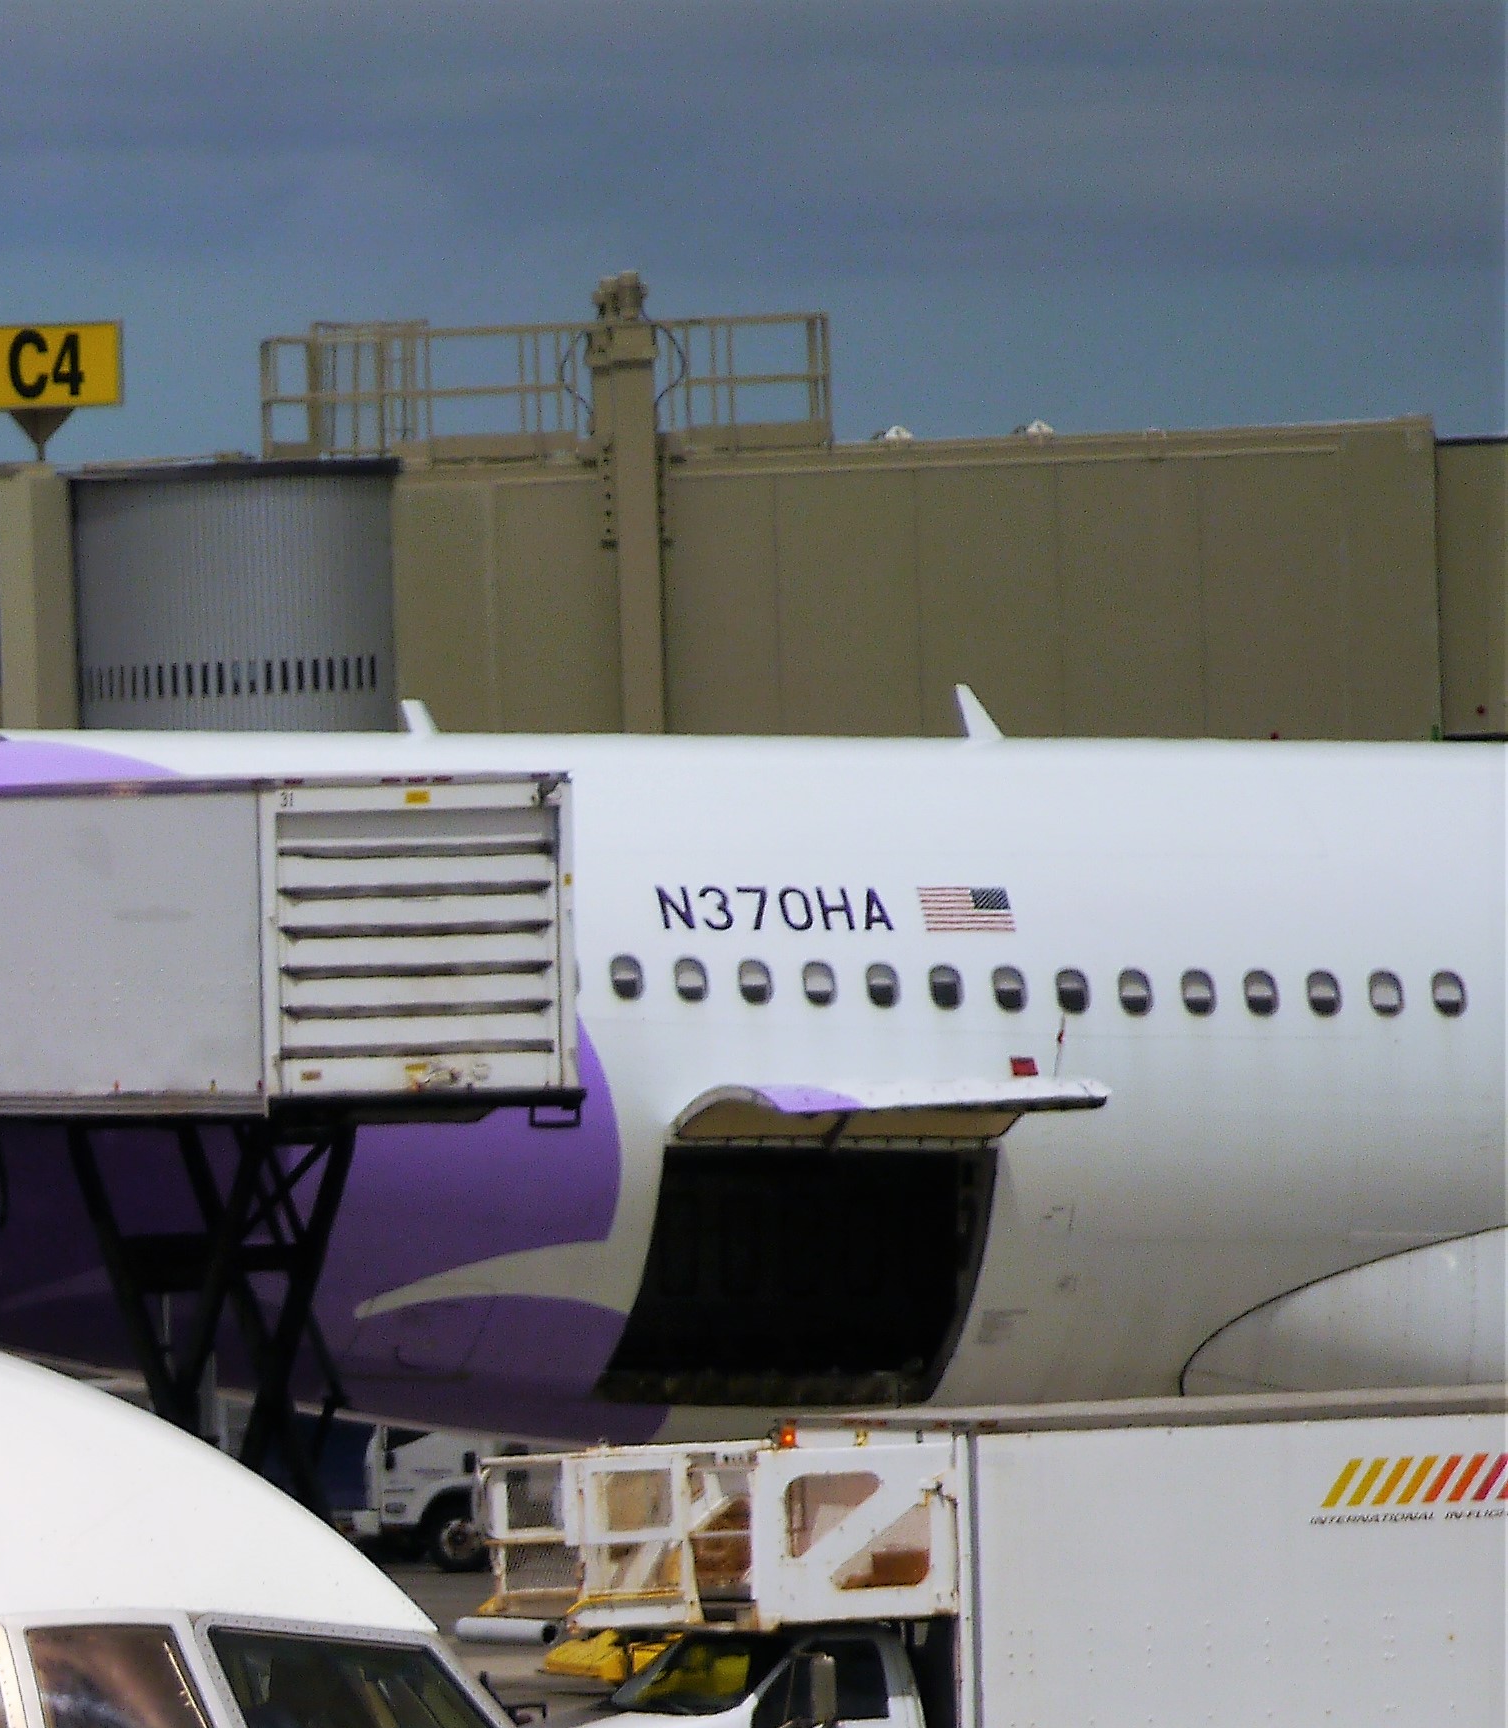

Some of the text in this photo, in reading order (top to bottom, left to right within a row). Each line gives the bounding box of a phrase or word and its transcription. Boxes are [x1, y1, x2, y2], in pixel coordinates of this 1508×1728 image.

[9, 329, 84, 398] C4
[655, 886, 895, 931] N370HA
[1309, 1511, 1435, 1525] INTERNATIONAL
